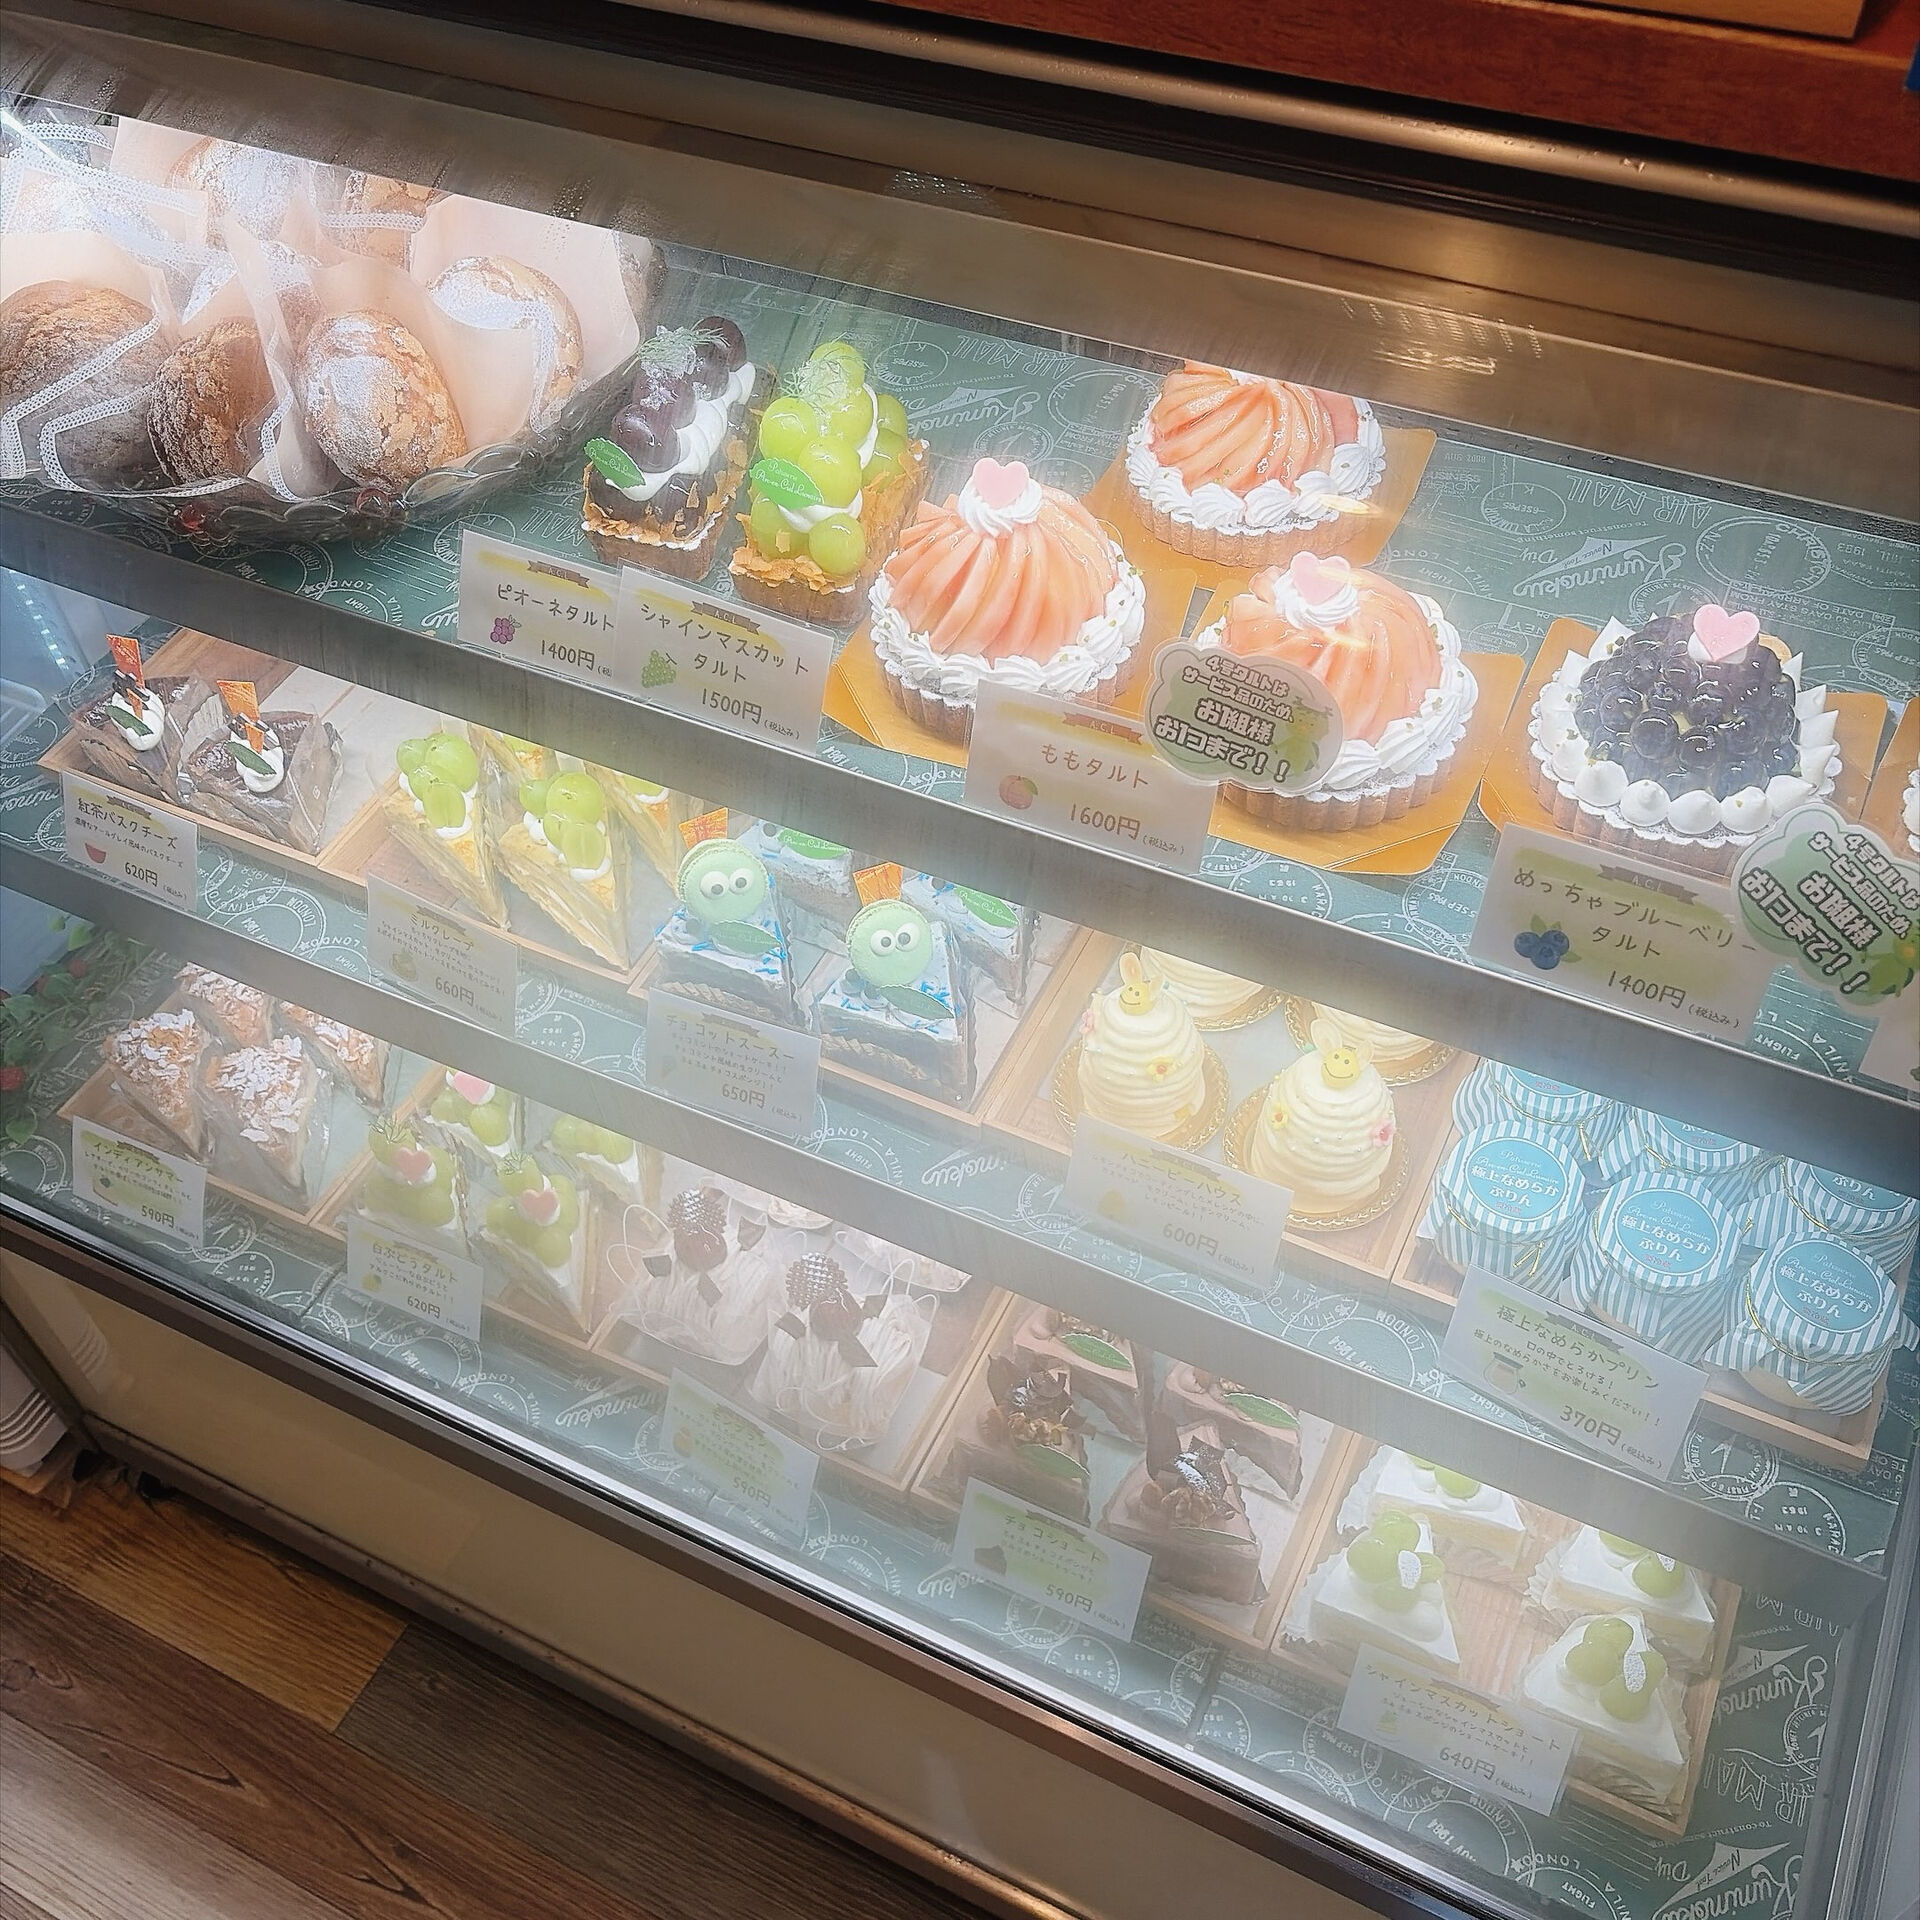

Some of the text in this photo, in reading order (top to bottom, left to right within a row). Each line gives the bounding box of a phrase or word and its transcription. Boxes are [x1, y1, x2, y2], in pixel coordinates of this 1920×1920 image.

[1567, 475, 1647, 517] MAIL
[497, 583, 614, 632] ピオーネタルト
[540, 640, 596, 673] 1400円
[639, 602, 809, 675] シャインマスカット
[694, 652, 747, 684] タルト
[701, 687, 763, 725] 1500円
[1041, 743, 1149, 789] ももタルト
[78, 797, 178, 850] 紅茶バスクチーズ
[1070, 803, 1142, 841] 1600円
[124, 861, 158, 888] 620円
[1513, 867, 1758, 952] めっちゃブルーベリー
[410, 913, 475, 951] ミルクレープ
[1592, 926, 1662, 958] タルト
[434, 976, 475, 1008] 660円
[1608, 969, 1687, 1009] 1400円
[665, 1014, 796, 1061] チョコットスースー
[721, 1082, 766, 1110] 650円
[93, 1142, 184, 1183] インディアンサマー
[1122, 1151, 1242, 1207] ハニービーハウス
[1470, 1164, 1560, 1197] 極上なめらか
[141, 1204, 175, 1229] 590円
[1621, 1214, 1711, 1256] 極上なめらか
[1162, 1222, 1220, 1258] 600円
[372, 1242, 458, 1284] 白ぶどうタルト
[407, 1295, 441, 1320] 620円
[1780, 1264, 1873, 1313] 極上なめらか
[1496, 1304, 1660, 1391] 極上なめらかプリン
[1526, 1341, 1615, 1391] 口の中でとろける！
[1559, 1404, 1624, 1447] 370円
[732, 1476, 772, 1508] 590円
[1004, 1515, 1103, 1563] チョコショート
[1045, 1583, 1094, 1613] 590円
[1366, 1664, 1561, 1752] シャインマスカットショート
[1439, 1746, 1497, 1781] 640円
